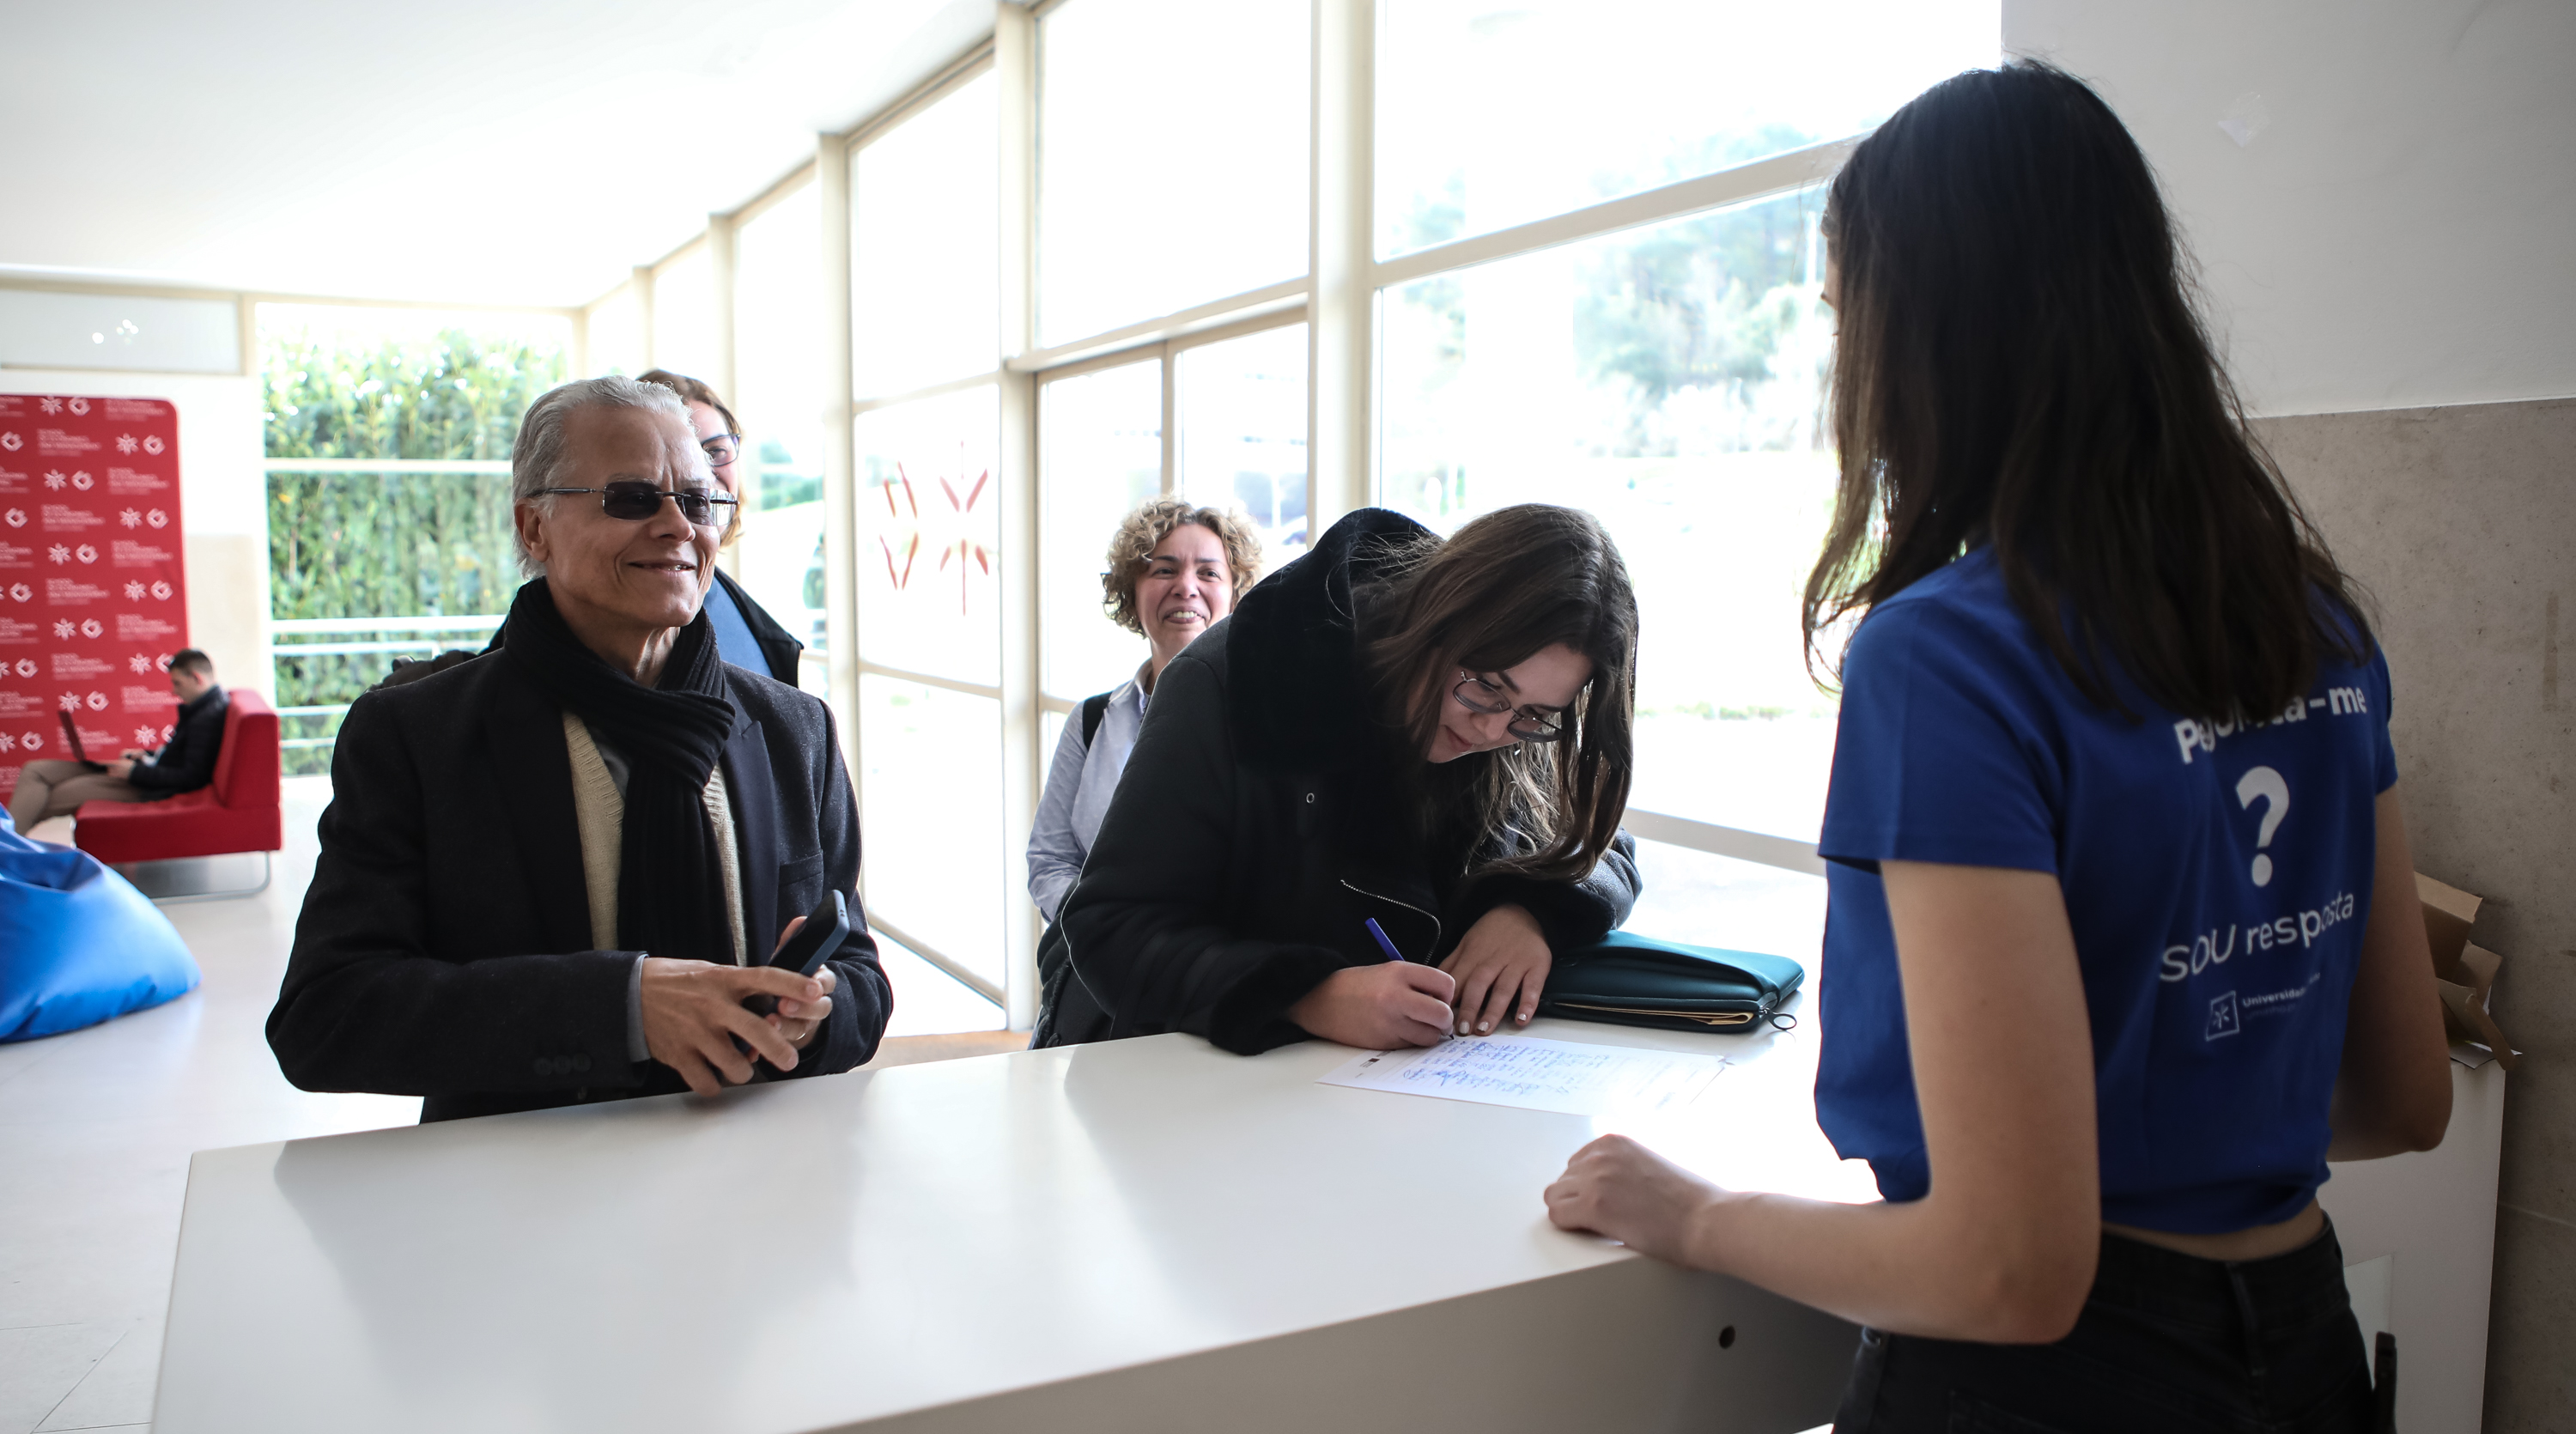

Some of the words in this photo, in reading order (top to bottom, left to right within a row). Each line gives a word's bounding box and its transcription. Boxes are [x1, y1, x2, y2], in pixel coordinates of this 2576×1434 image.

[2235, 765, 2290, 887] ?
[2246, 890, 2354, 956] resposta
[2242, 987, 2306, 1008] Universida
